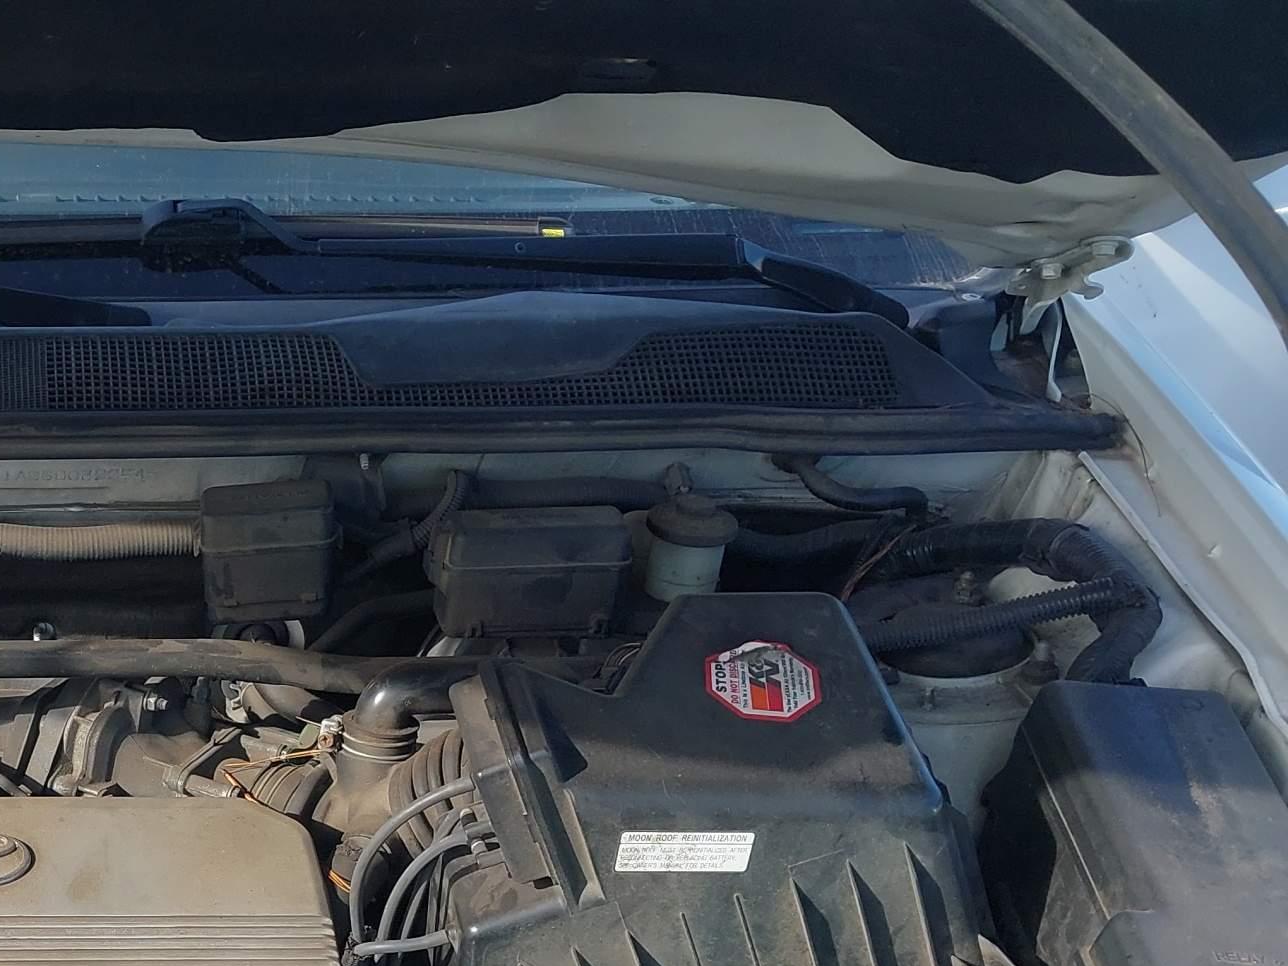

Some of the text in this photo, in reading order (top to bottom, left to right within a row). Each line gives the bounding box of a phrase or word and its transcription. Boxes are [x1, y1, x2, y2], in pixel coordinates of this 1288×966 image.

[628, 834, 748, 843] MOON ROOF REINITIALIZATION
